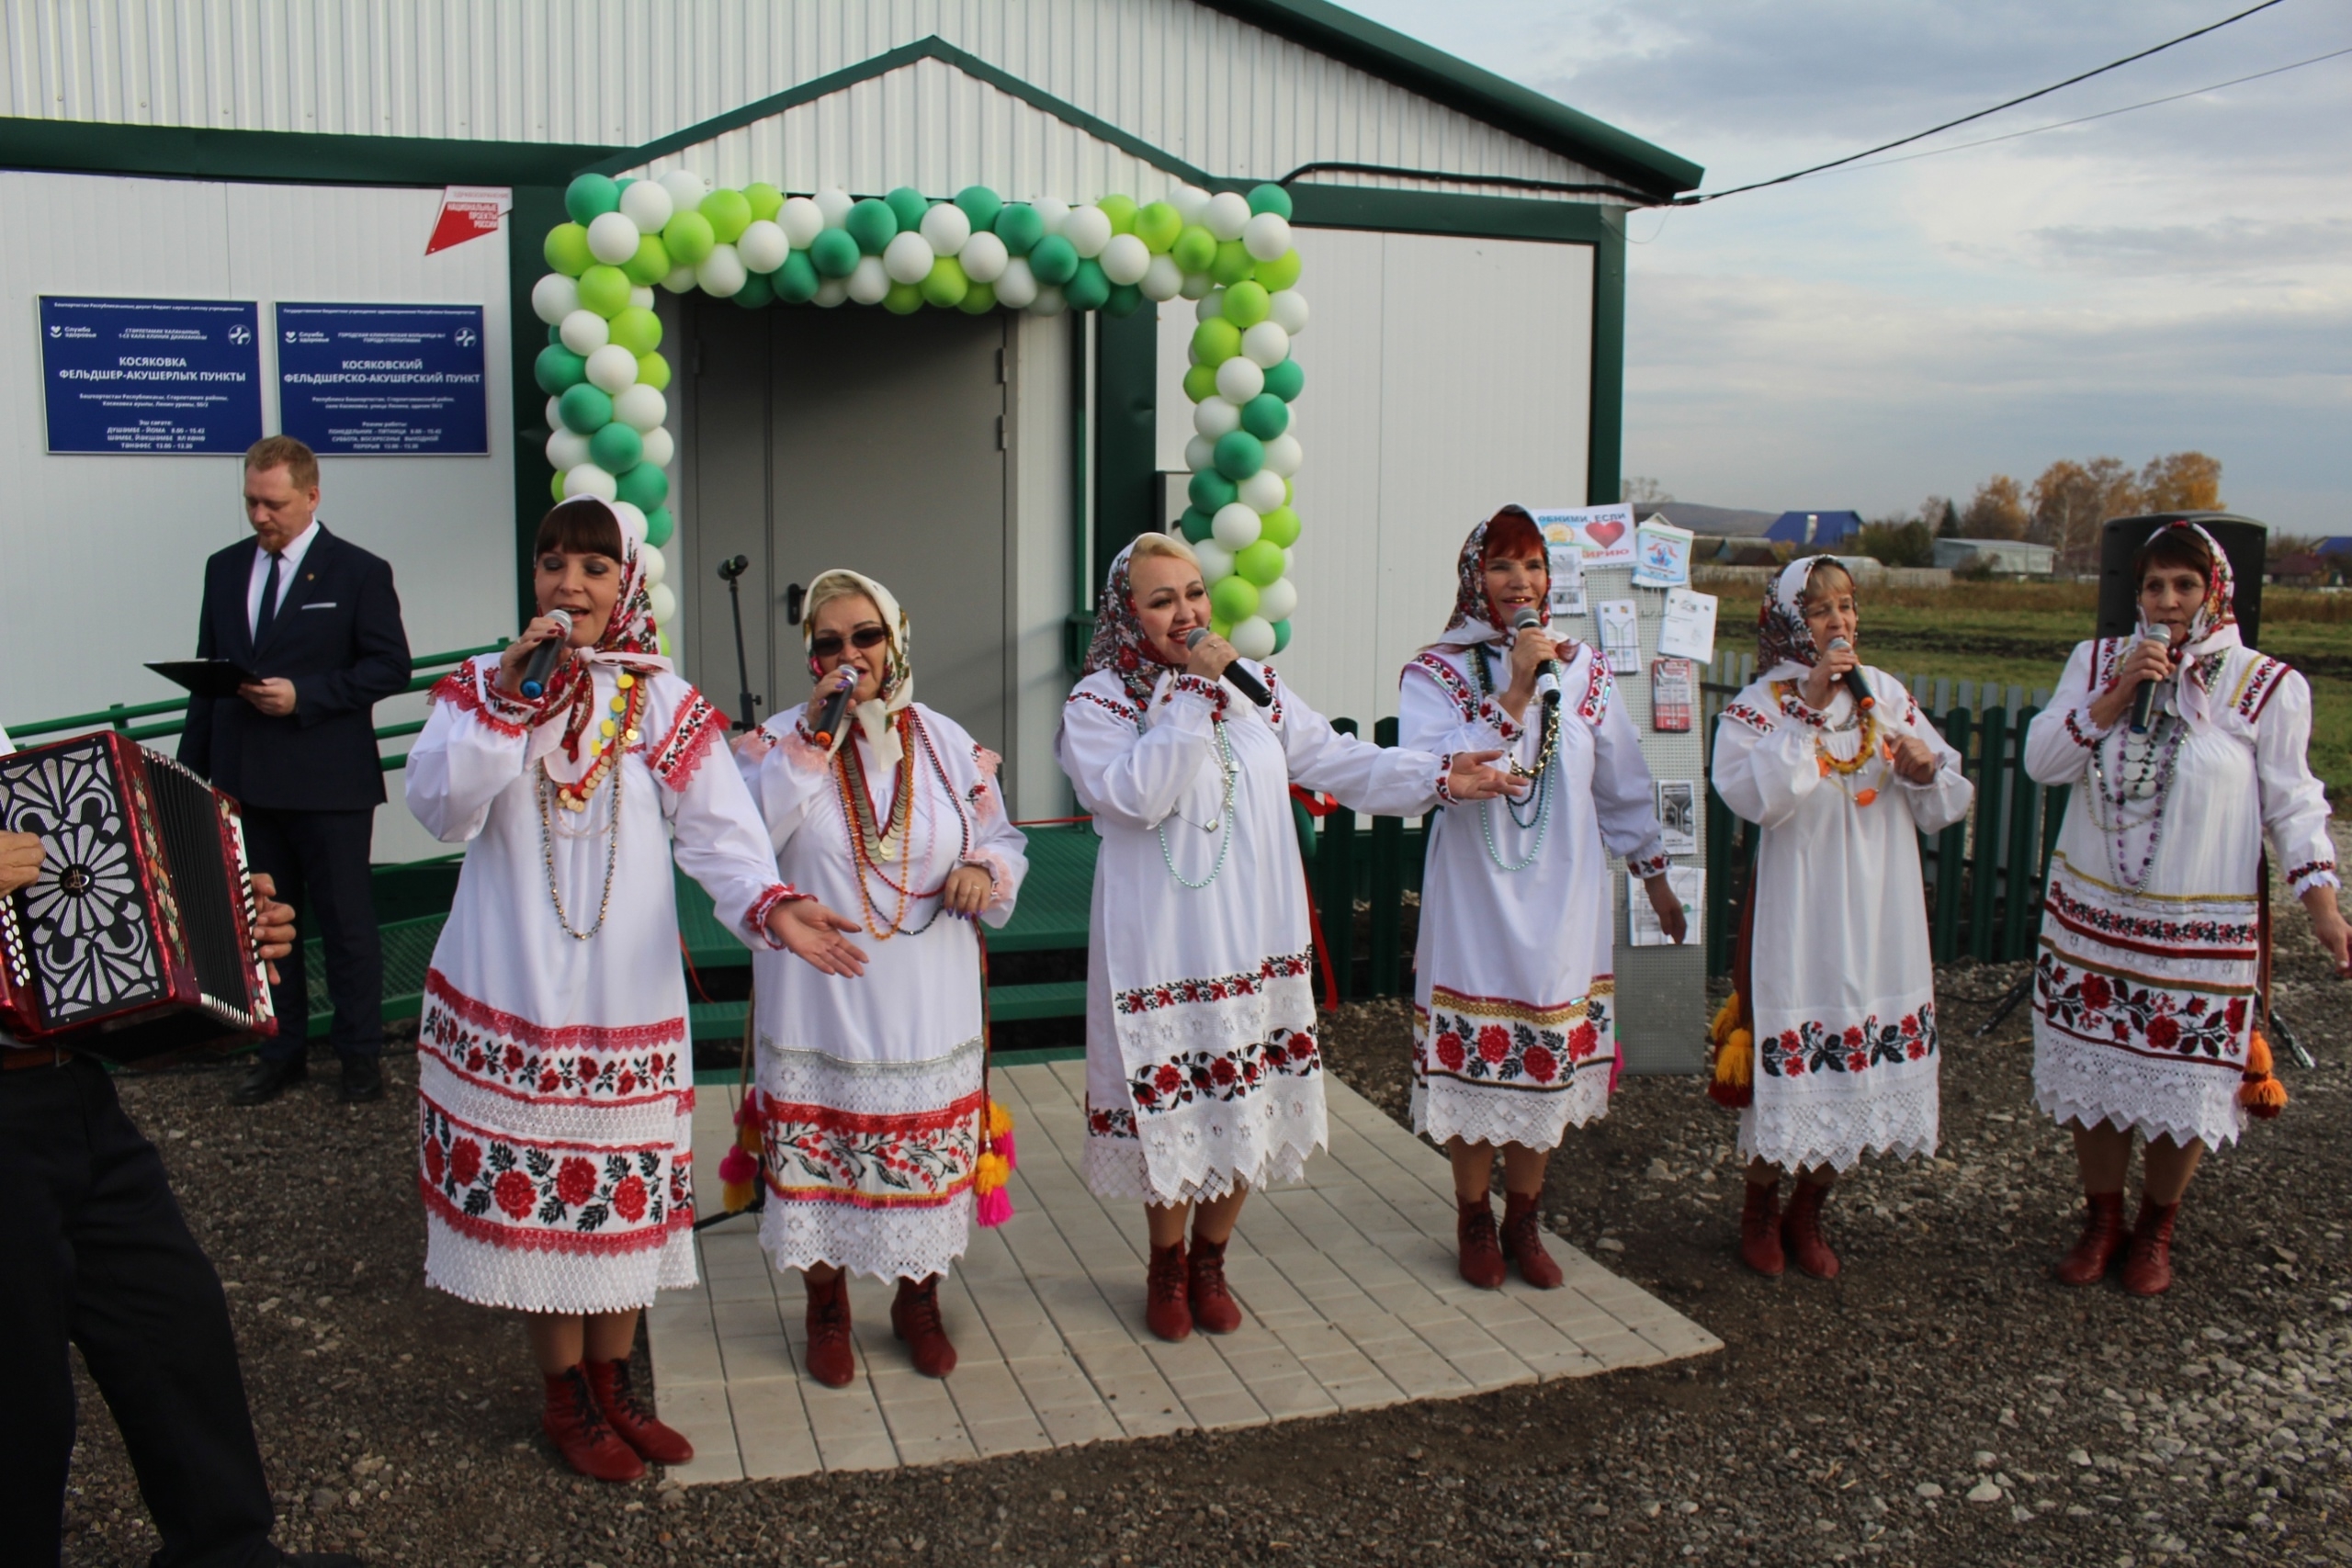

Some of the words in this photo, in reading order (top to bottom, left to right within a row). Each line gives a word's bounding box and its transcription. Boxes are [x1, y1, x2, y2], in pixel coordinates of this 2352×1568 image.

[119, 356, 187, 367] КОСЯКОВКА
[342, 359, 423, 370] КОСЯКОВСКИЙ
[199, 371, 246, 382] ПУНКТЫ
[284, 372, 443, 385] ФЕЛЬДШЕРСКО-АКУШЕРСКИЙ
[446, 374, 481, 384] ПУНКТ
[1594, 513, 1626, 522] ЕСЛИ
